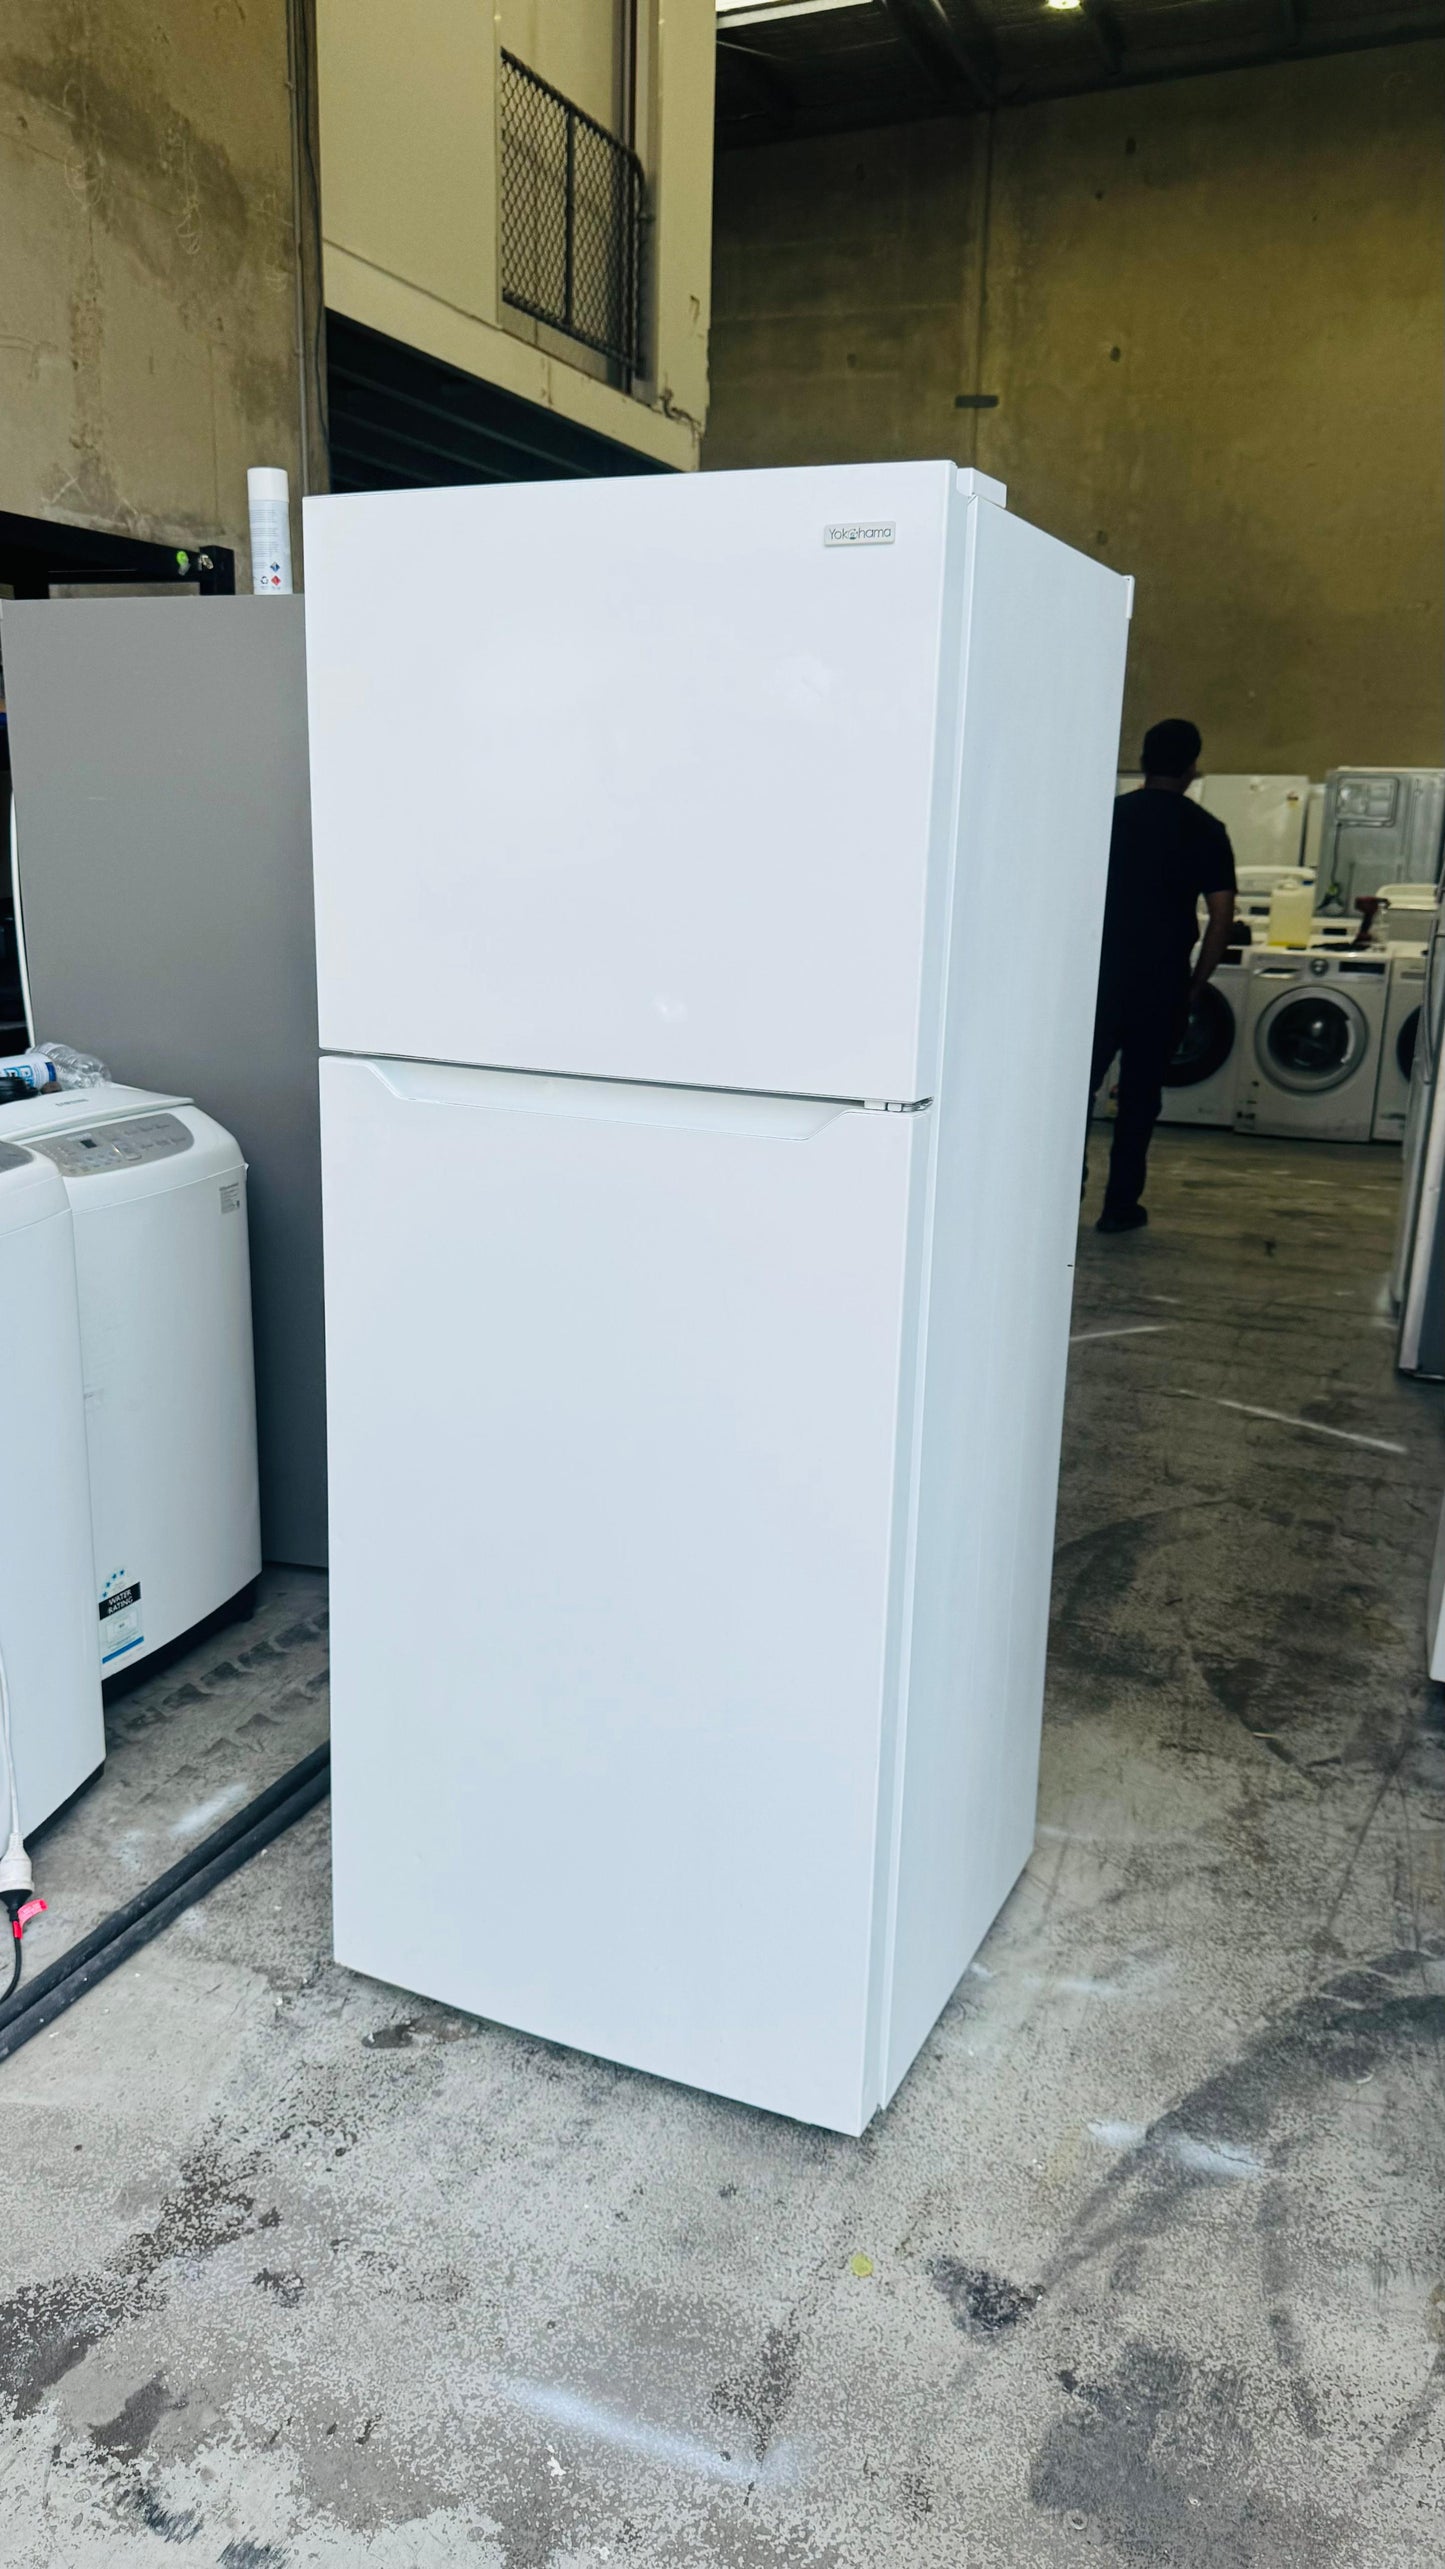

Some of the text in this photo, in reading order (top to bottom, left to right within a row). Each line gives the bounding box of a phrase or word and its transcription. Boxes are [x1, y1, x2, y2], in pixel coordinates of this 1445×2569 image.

[829, 527, 892, 540] Yokohama
[107, 1596, 134, 1614] RATING
[108, 1589, 132, 1606] WATER
